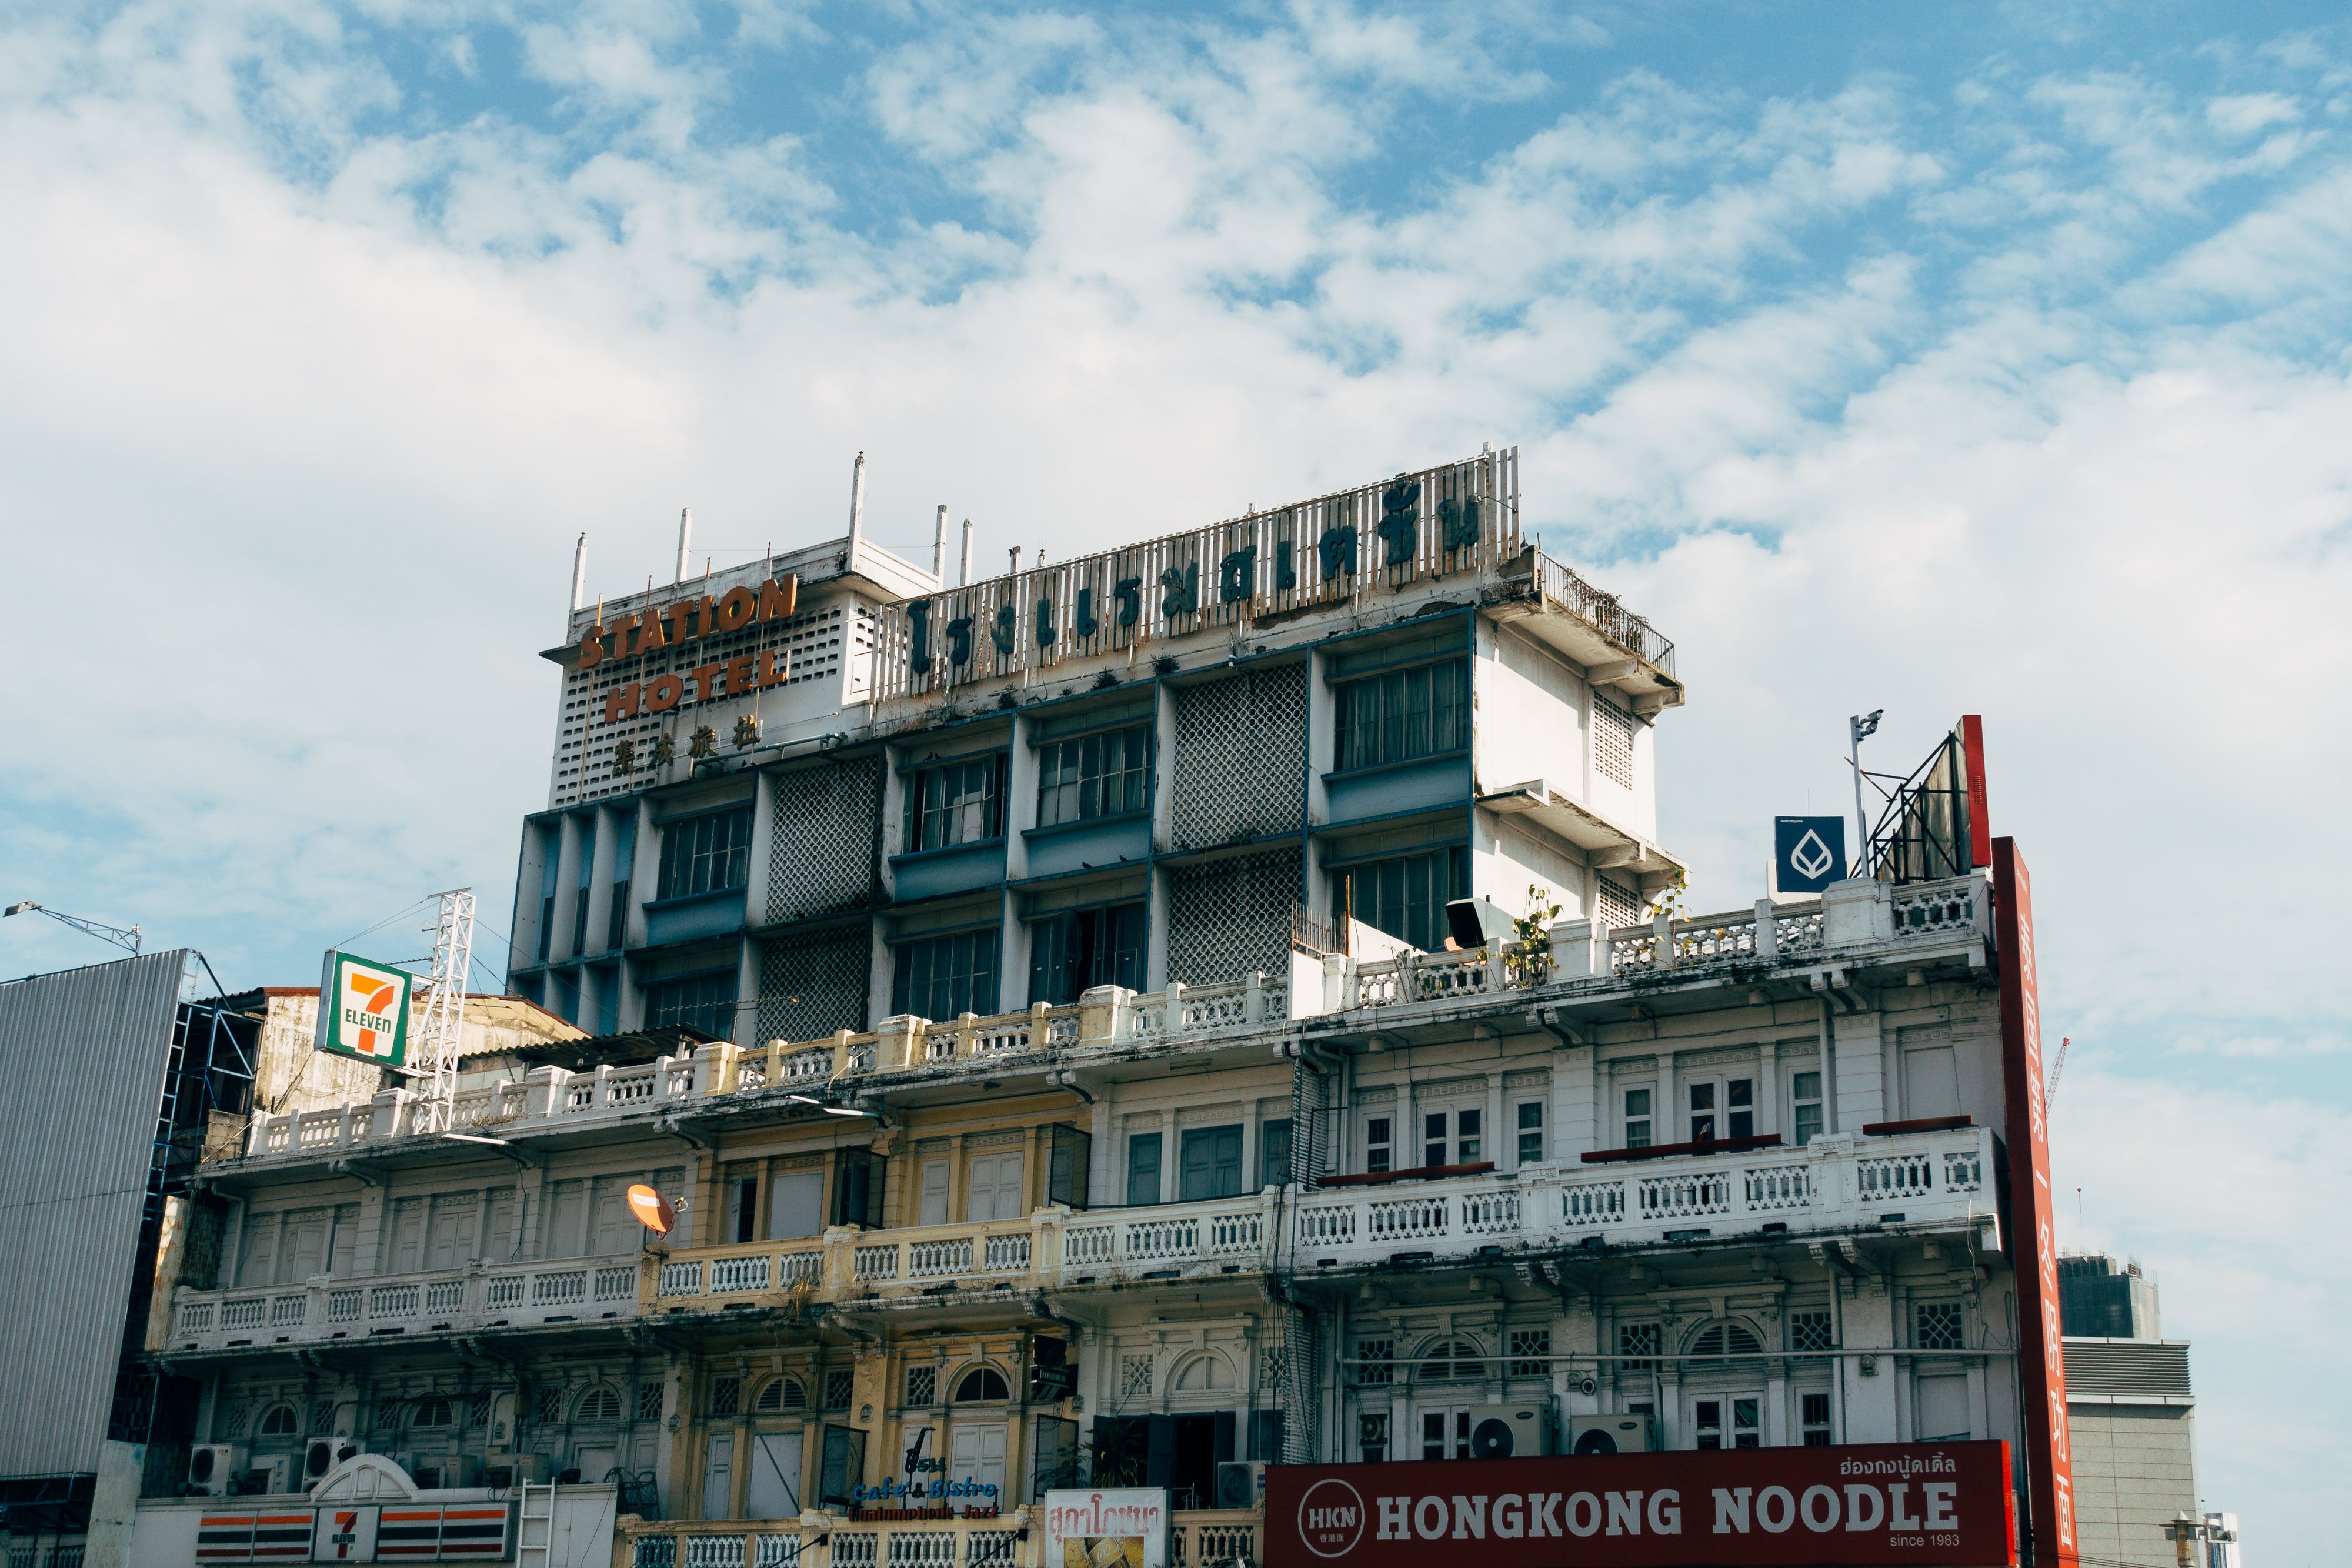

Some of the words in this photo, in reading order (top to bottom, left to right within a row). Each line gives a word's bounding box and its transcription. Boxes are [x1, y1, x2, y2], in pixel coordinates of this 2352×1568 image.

[579, 573, 798, 669] STATION
[605, 650, 788, 723] HOTEL
[350, 972, 395, 1054] 7
[912, 1482, 925, 1498] &
[930, 1476, 997, 1499] Bistro
[1377, 1488, 1682, 1540] HONGKONG
[1712, 1482, 1959, 1534] NOODLE
[335, 1511, 358, 1558] 7
[961, 1504, 1000, 1519] Jazz
[1309, 1506, 1356, 1529] HKN
[1890, 1534, 1924, 1546] since
[1930, 1533, 1960, 1546] 1983
